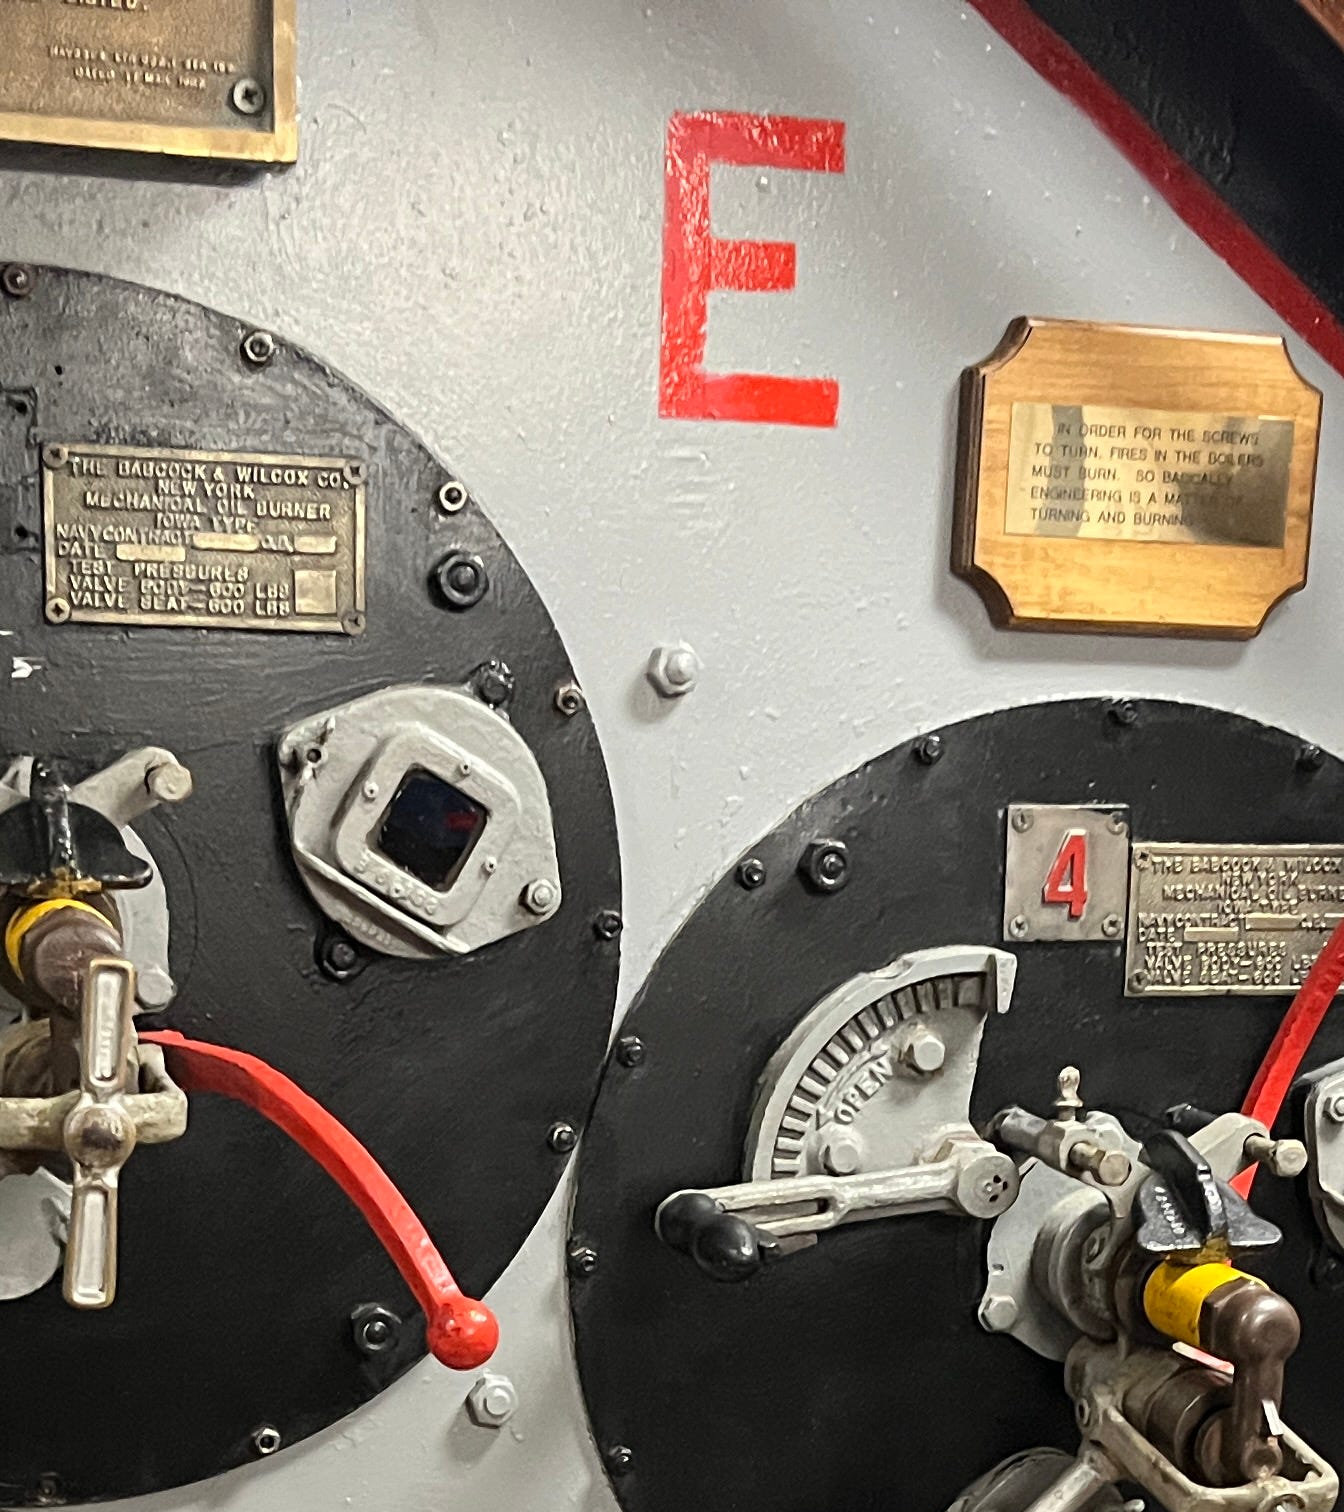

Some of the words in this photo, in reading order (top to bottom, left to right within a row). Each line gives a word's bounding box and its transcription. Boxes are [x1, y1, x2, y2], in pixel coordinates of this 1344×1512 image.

[658, 109, 846, 429] E
[1079, 423, 1126, 439] ORDER
[1134, 425, 1161, 440] FOR
[1169, 428, 1195, 442] THE
[1035, 442, 1053, 457] TO
[1110, 446, 1148, 462] FIRES
[1154, 449, 1168, 462] IN
[1174, 449, 1201, 465] THE
[71, 457, 106, 478] THE
[117, 460, 206, 479] BABCOCK
[236, 465, 309, 486] WILCOX
[317, 472, 350, 489] CO.
[1031, 464, 1070, 480] MUST
[1136, 469, 1155, 483] SO
[157, 478, 198, 496] NEW
[204, 481, 255, 500] YORK
[1030, 485, 1122, 504] ENGINEERING
[1129, 490, 1141, 505] IS
[1147, 491, 1157, 505] A
[85, 490, 207, 512] MECHANICAL
[217, 498, 248, 516] OIL
[256, 500, 331, 520] BURNER
[1031, 507, 1090, 524] TURNING
[1098, 511, 1126, 525] AND
[58, 541, 106, 559] DATE
[70, 559, 114, 575] TEST
[133, 562, 249, 582] PRESSURES
[70, 574, 128, 593] VALVE
[70, 590, 127, 609] VALVE
[1042, 828, 1088, 920] 4
[834, 1056, 893, 1125] OPEN
